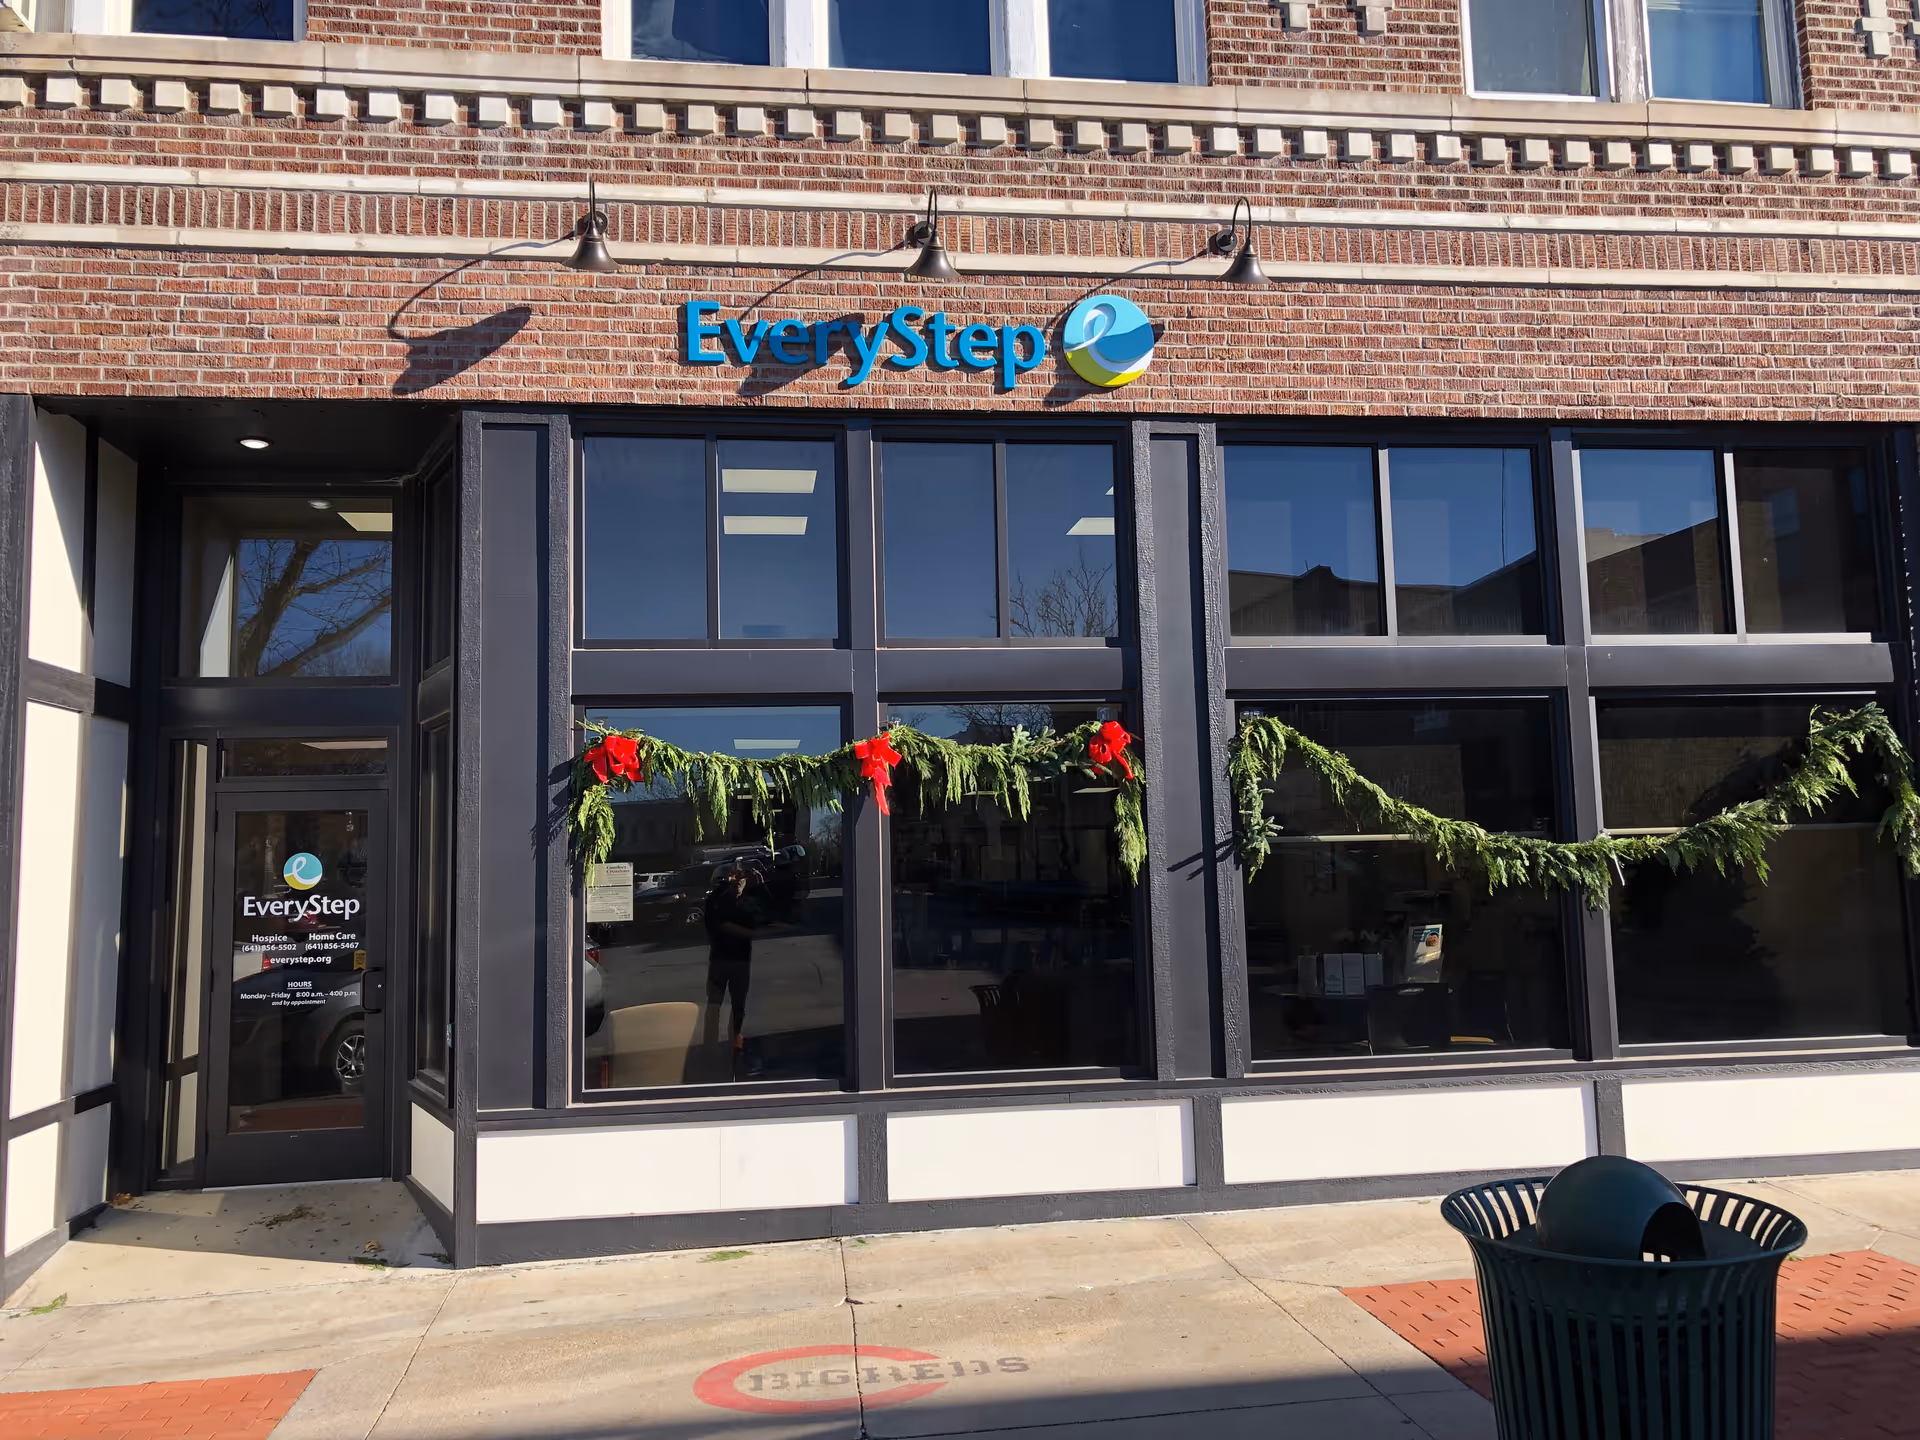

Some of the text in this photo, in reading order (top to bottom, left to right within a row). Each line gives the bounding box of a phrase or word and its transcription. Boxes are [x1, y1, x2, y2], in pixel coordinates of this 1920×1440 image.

[686, 299, 1046, 389] EveryStep
[243, 894, 360, 922] EveryStep
[252, 934, 288, 943] Hospice
[308, 932, 334, 940] Home
[270, 956, 332, 965] everystep.org
